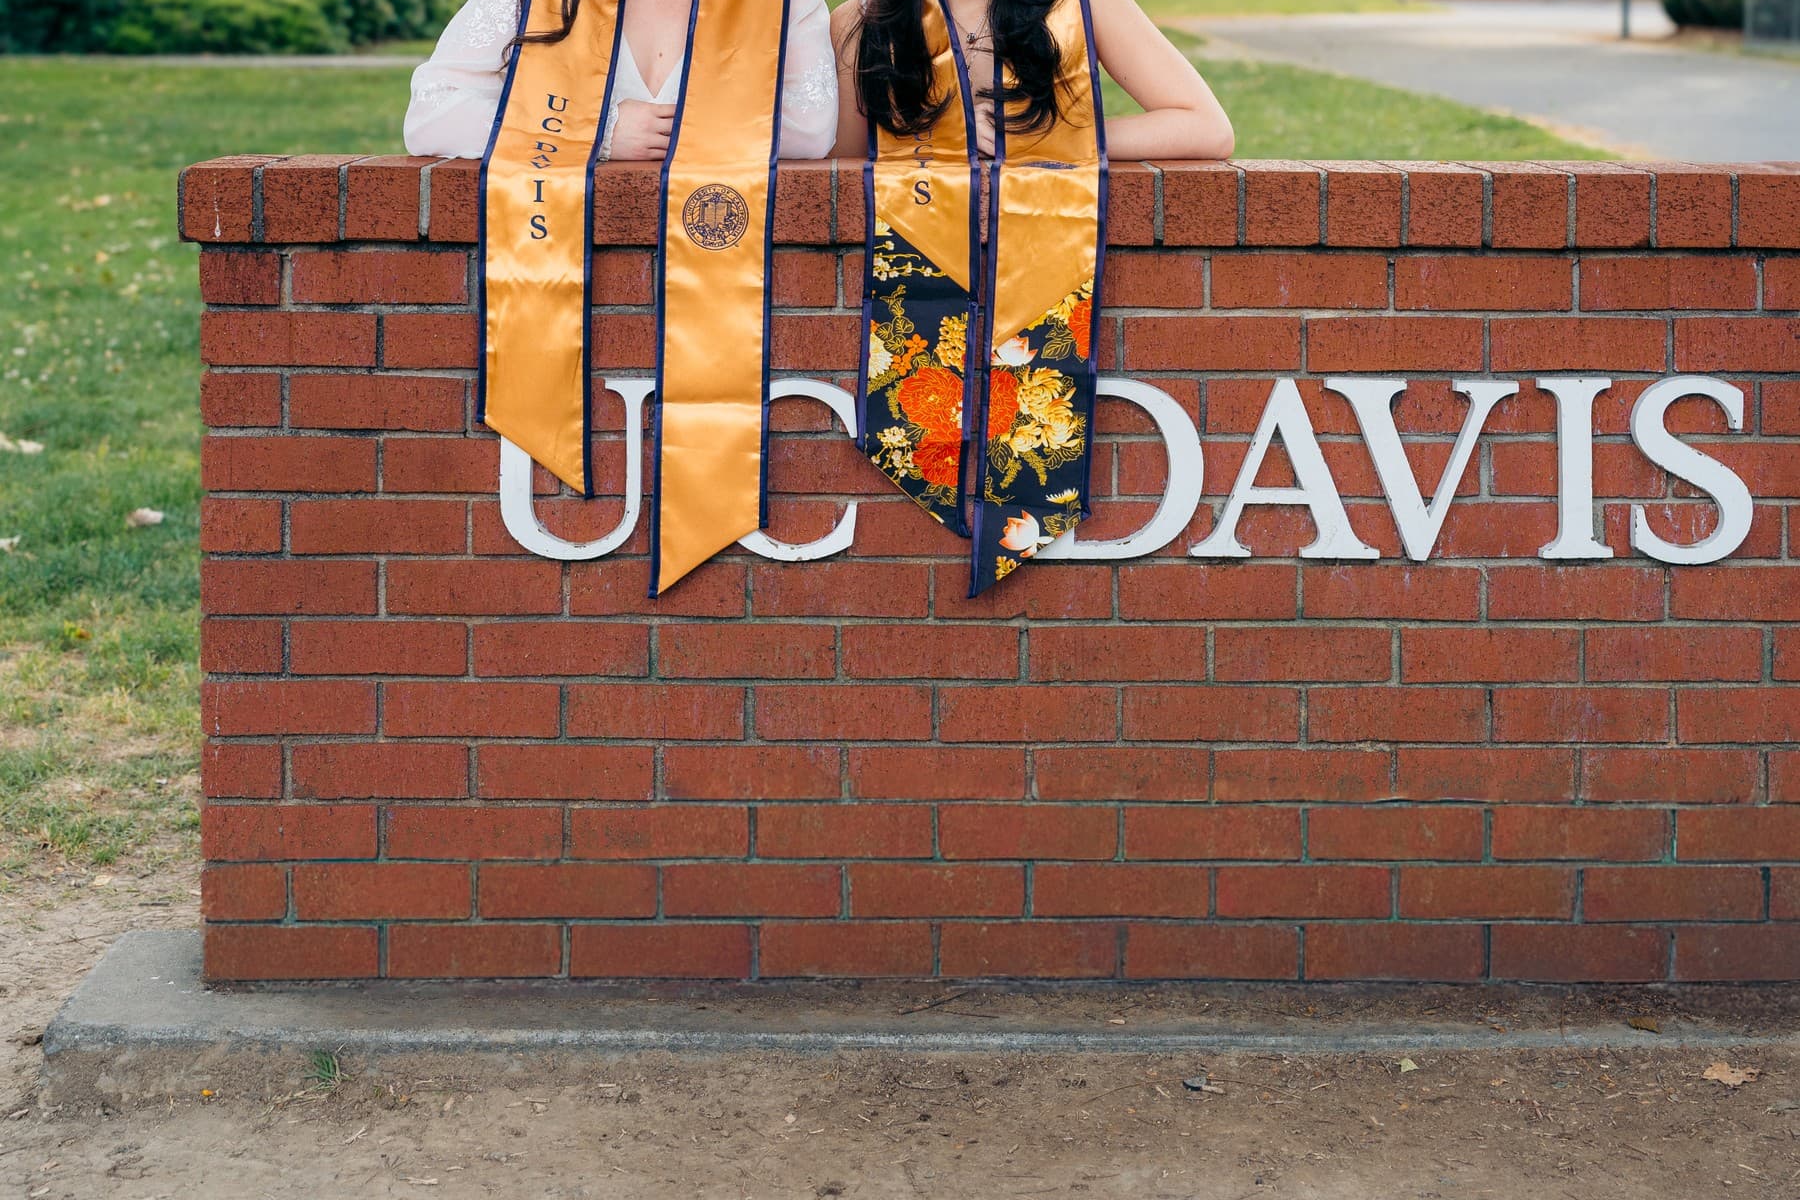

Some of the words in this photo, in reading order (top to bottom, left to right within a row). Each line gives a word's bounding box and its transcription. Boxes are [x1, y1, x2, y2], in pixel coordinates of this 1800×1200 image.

[686, 187, 717, 216] UNIVERSITY
[732, 196, 746, 237] CALIFORNIA
[499, 378, 858, 561] UC
[1031, 374, 1753, 565] DAVIS
